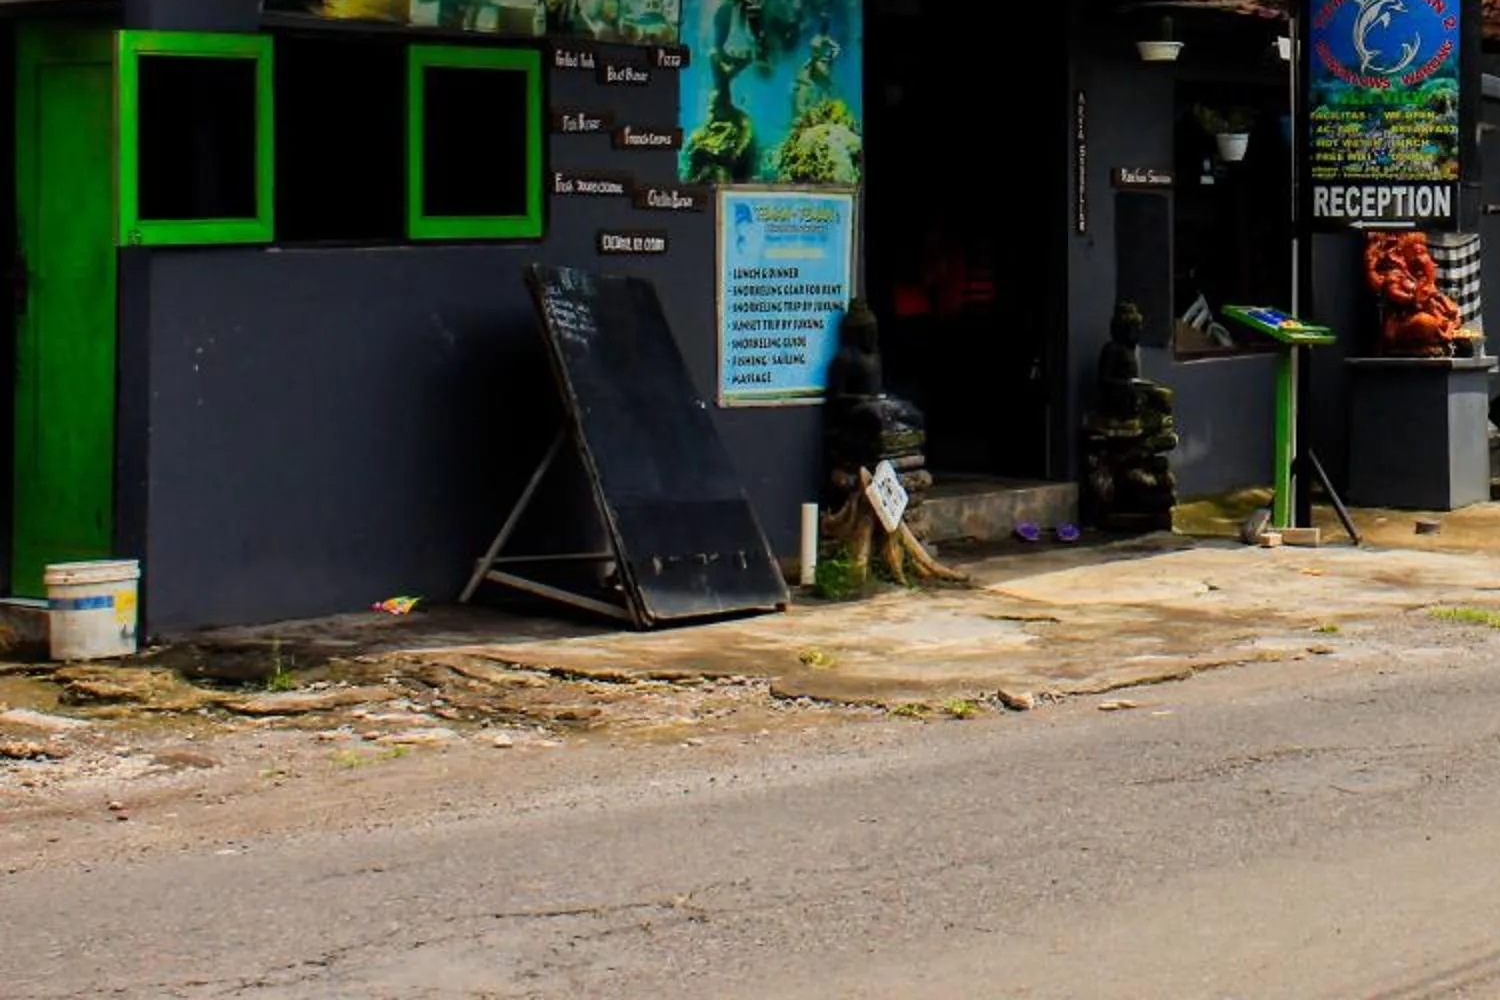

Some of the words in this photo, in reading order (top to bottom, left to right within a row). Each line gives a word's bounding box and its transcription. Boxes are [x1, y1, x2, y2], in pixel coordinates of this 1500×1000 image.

[1312, 184, 1452, 218] RECEPTION
[733, 267, 762, 280] LUNCH
[769, 267, 799, 279] DINNER
[784, 284, 804, 296] GEAR
[805, 284, 821, 296] FOR
[822, 283, 842, 295] RENT
[783, 301, 801, 313] TRIP
[763, 319, 780, 331] TRIP
[732, 356, 767, 367] FISHING
[772, 354, 806, 365] SAILING
